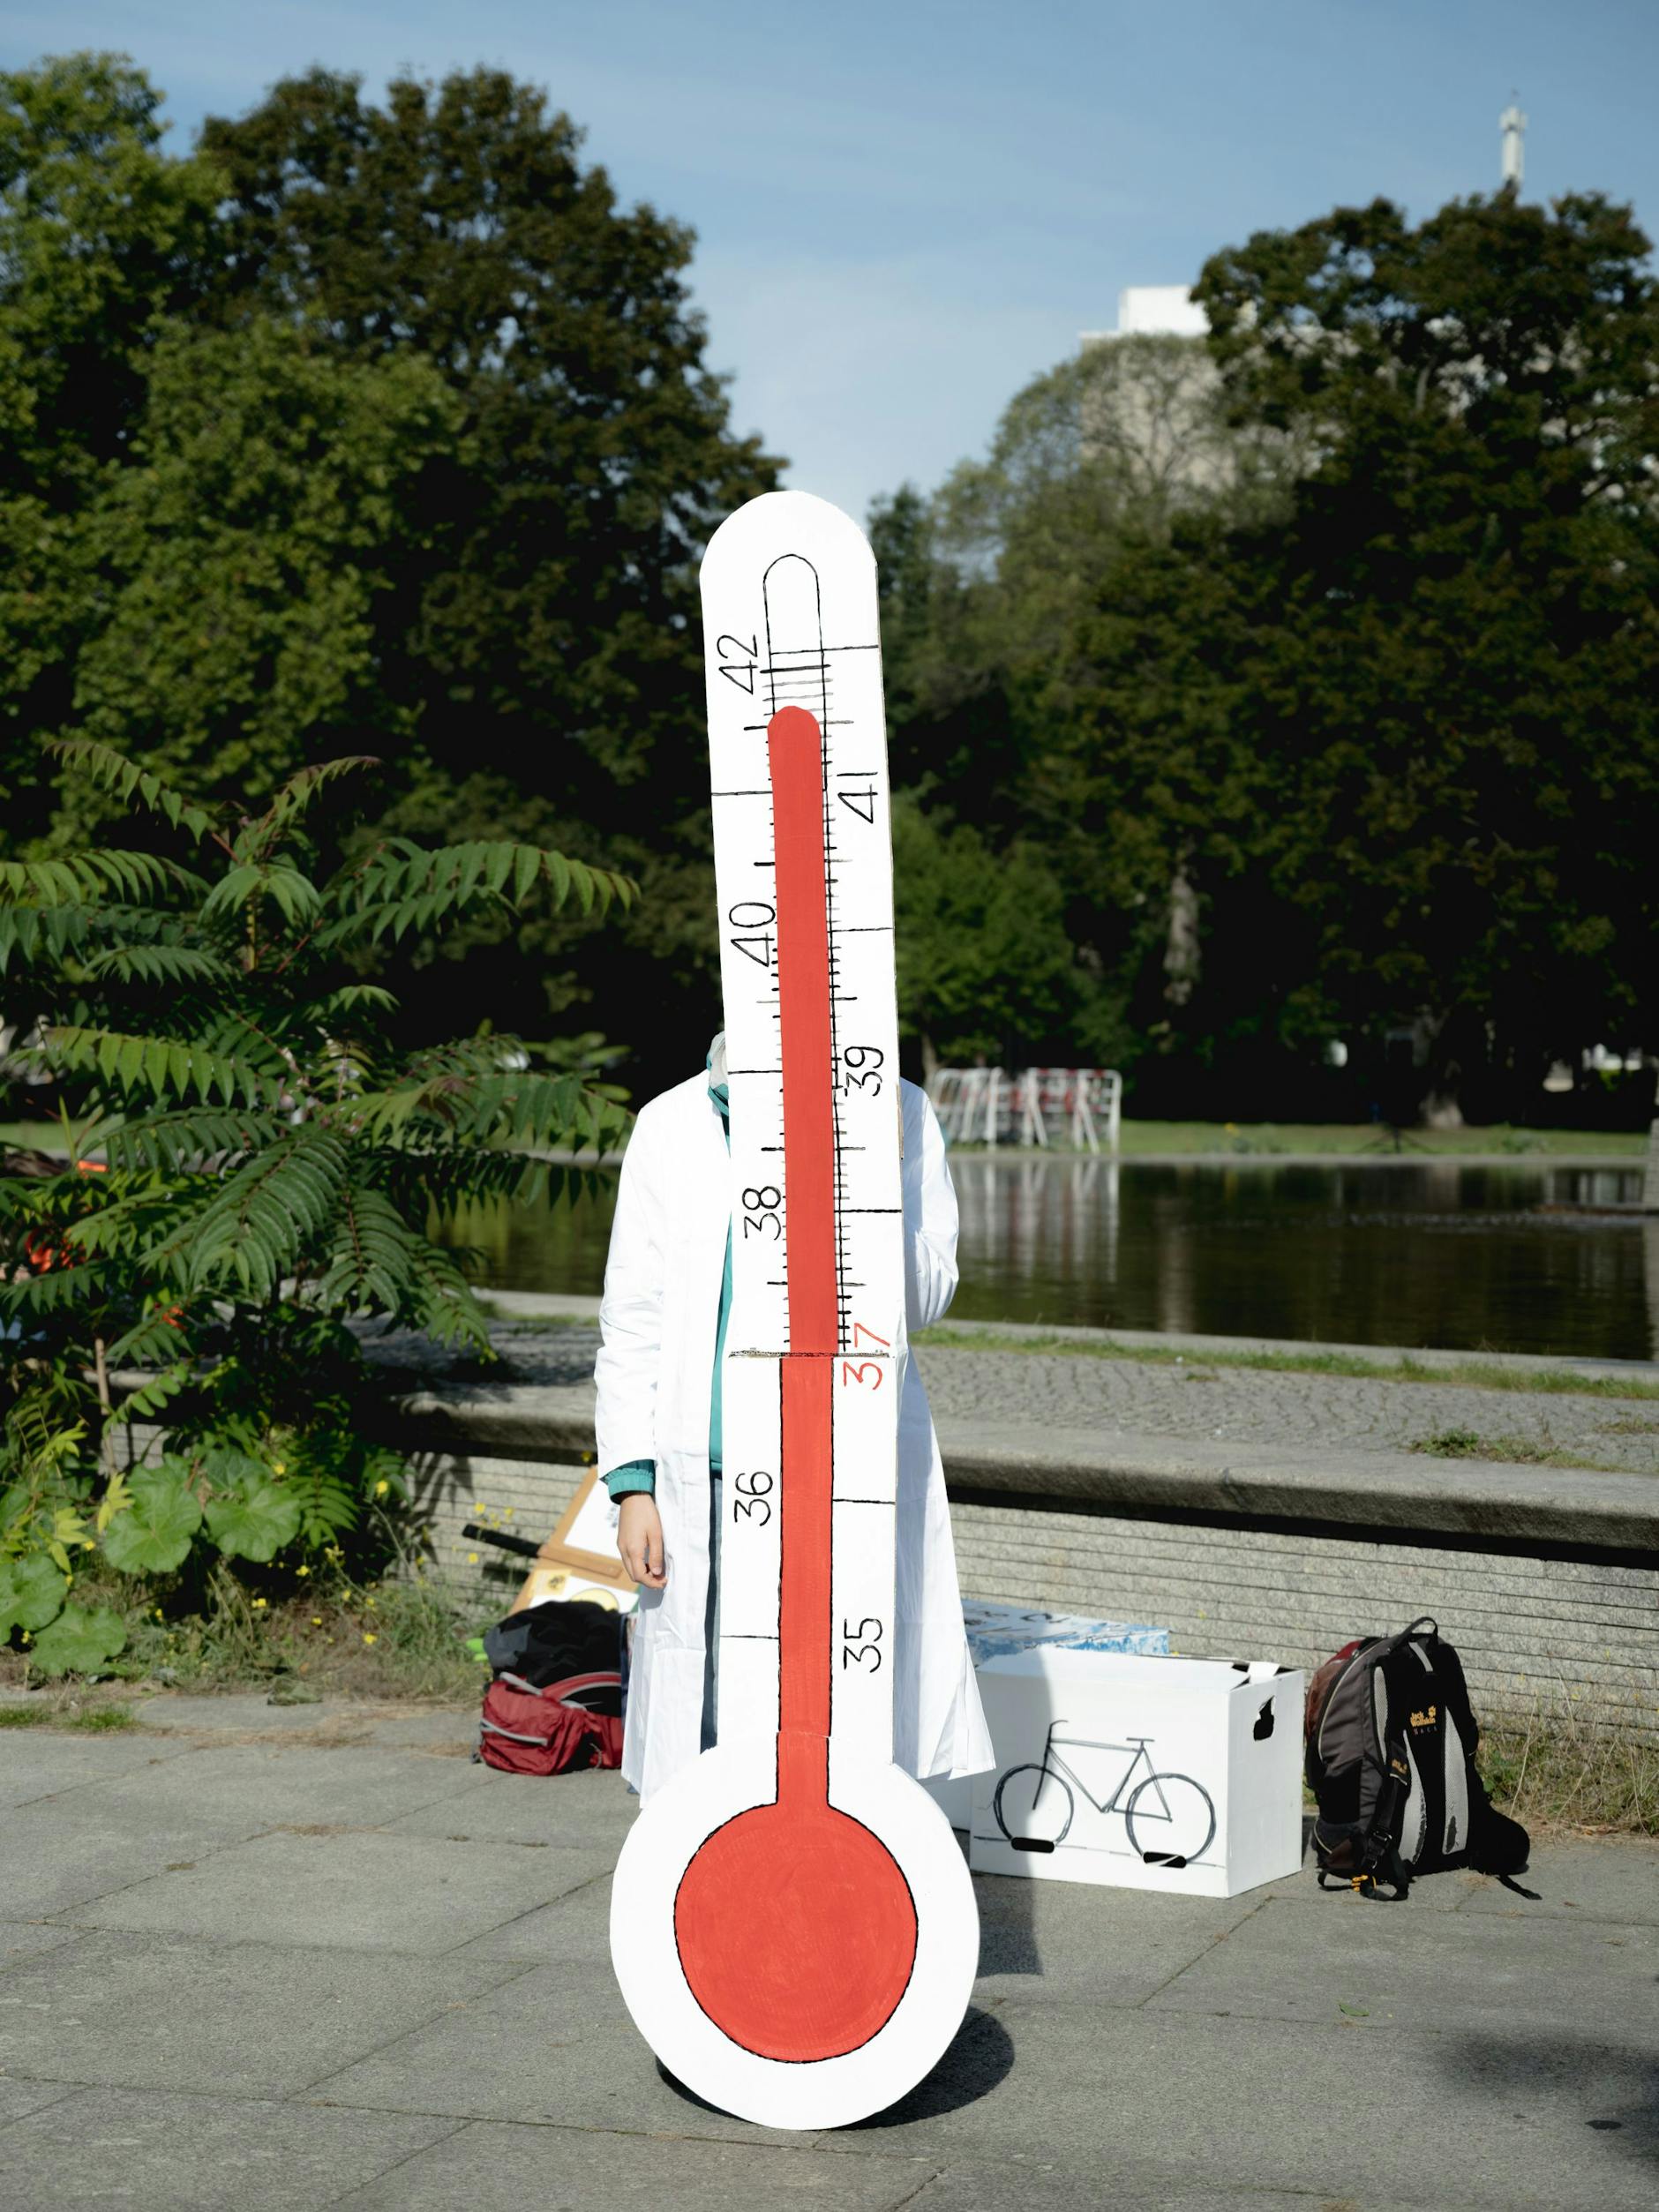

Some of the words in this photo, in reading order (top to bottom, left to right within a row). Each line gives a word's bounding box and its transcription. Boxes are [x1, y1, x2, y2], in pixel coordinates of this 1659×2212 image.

[716, 634, 759, 695] 42
[837, 771, 879, 824] 41
[729, 902, 776, 967] 40
[844, 1046, 884, 1097] 39
[742, 1186, 782, 1241] 38
[843, 1323, 890, 1391] 37
[734, 1471, 774, 1526] 36
[844, 1617, 883, 1674] 35
